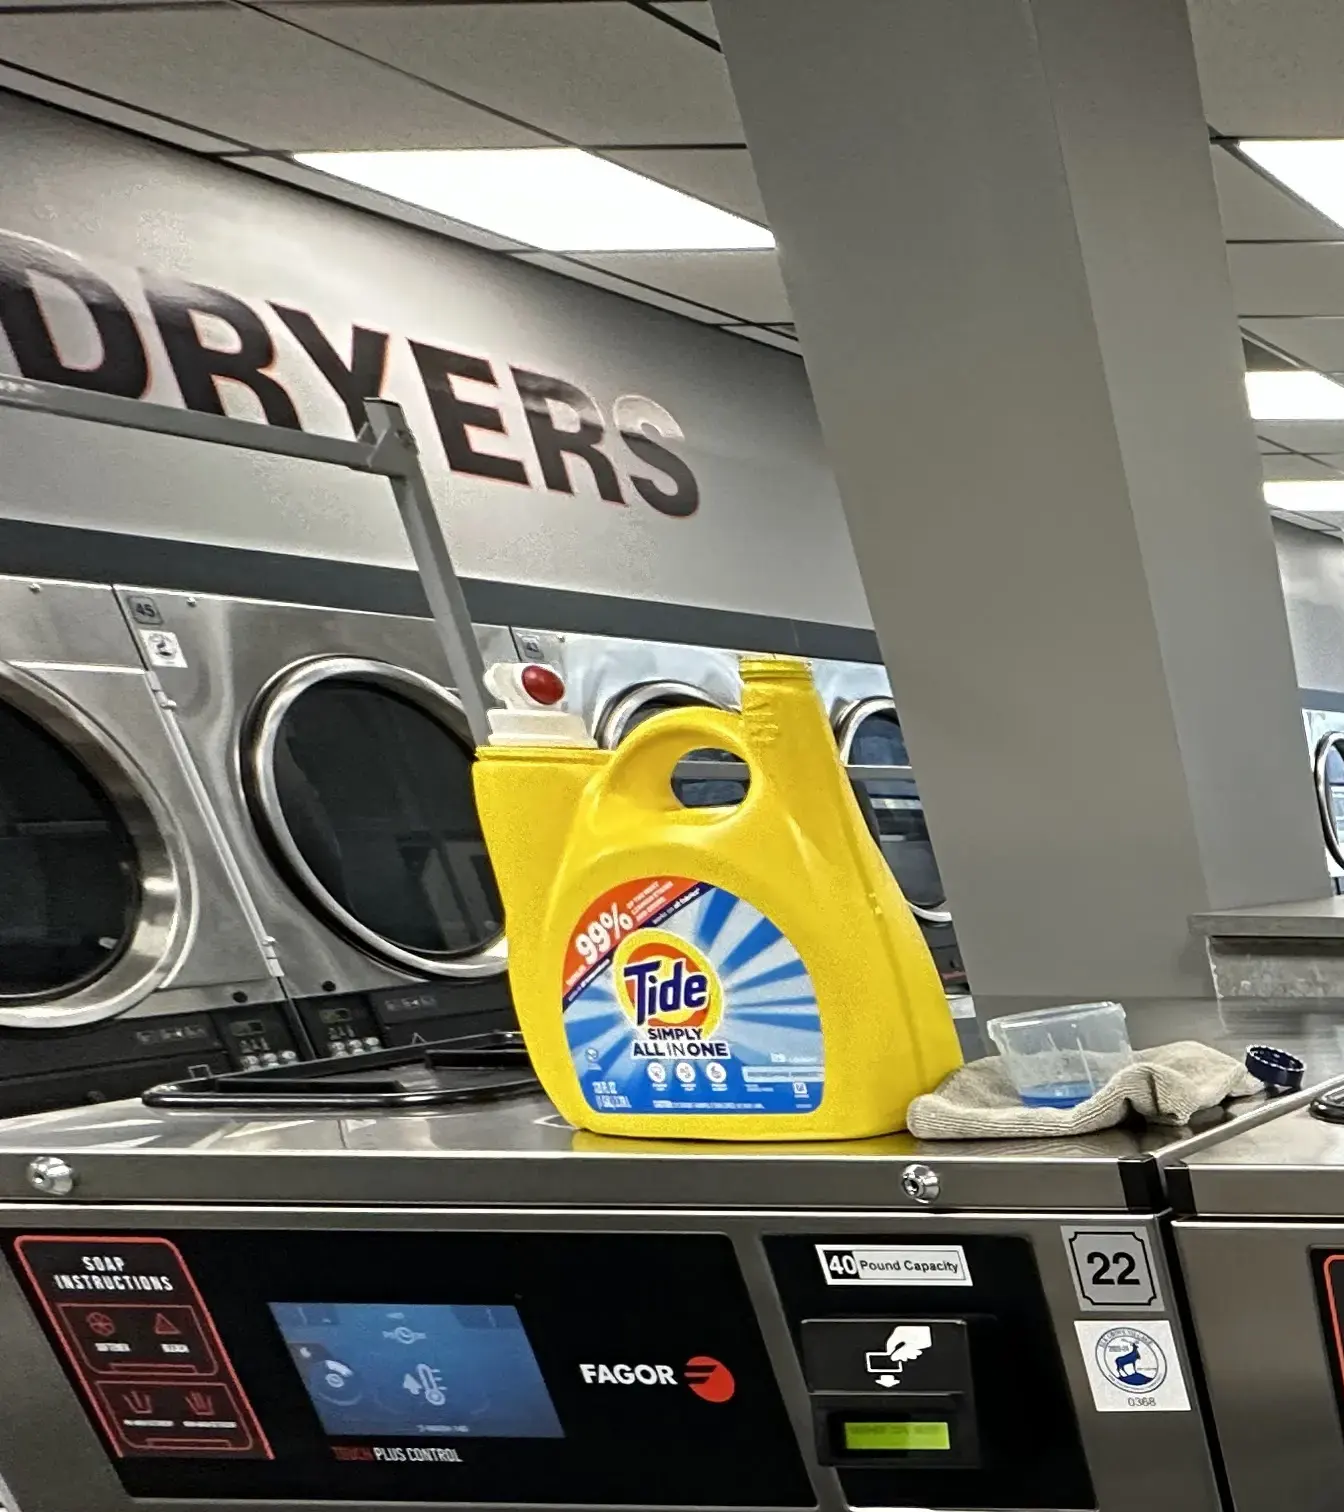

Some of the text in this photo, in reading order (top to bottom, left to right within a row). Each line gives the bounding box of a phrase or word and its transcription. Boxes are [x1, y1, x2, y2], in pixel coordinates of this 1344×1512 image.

[0, 230, 700, 517] DRYERS
[575, 902, 633, 965] 99%
[623, 958, 708, 1027] Tide
[648, 1028, 703, 1041] SIMPLY
[633, 1043, 728, 1057] ALL IN ONE
[81, 1256, 125, 1272] SOAP
[828, 1254, 959, 1275] 40 Pound Capacity
[1086, 1252, 1140, 1285] 22
[53, 1275, 173, 1291] INSTRUCTIONS
[579, 1364, 678, 1385] FAGOR
[373, 1447, 406, 1461] PLUS
[405, 1447, 463, 1462] CONTROL
